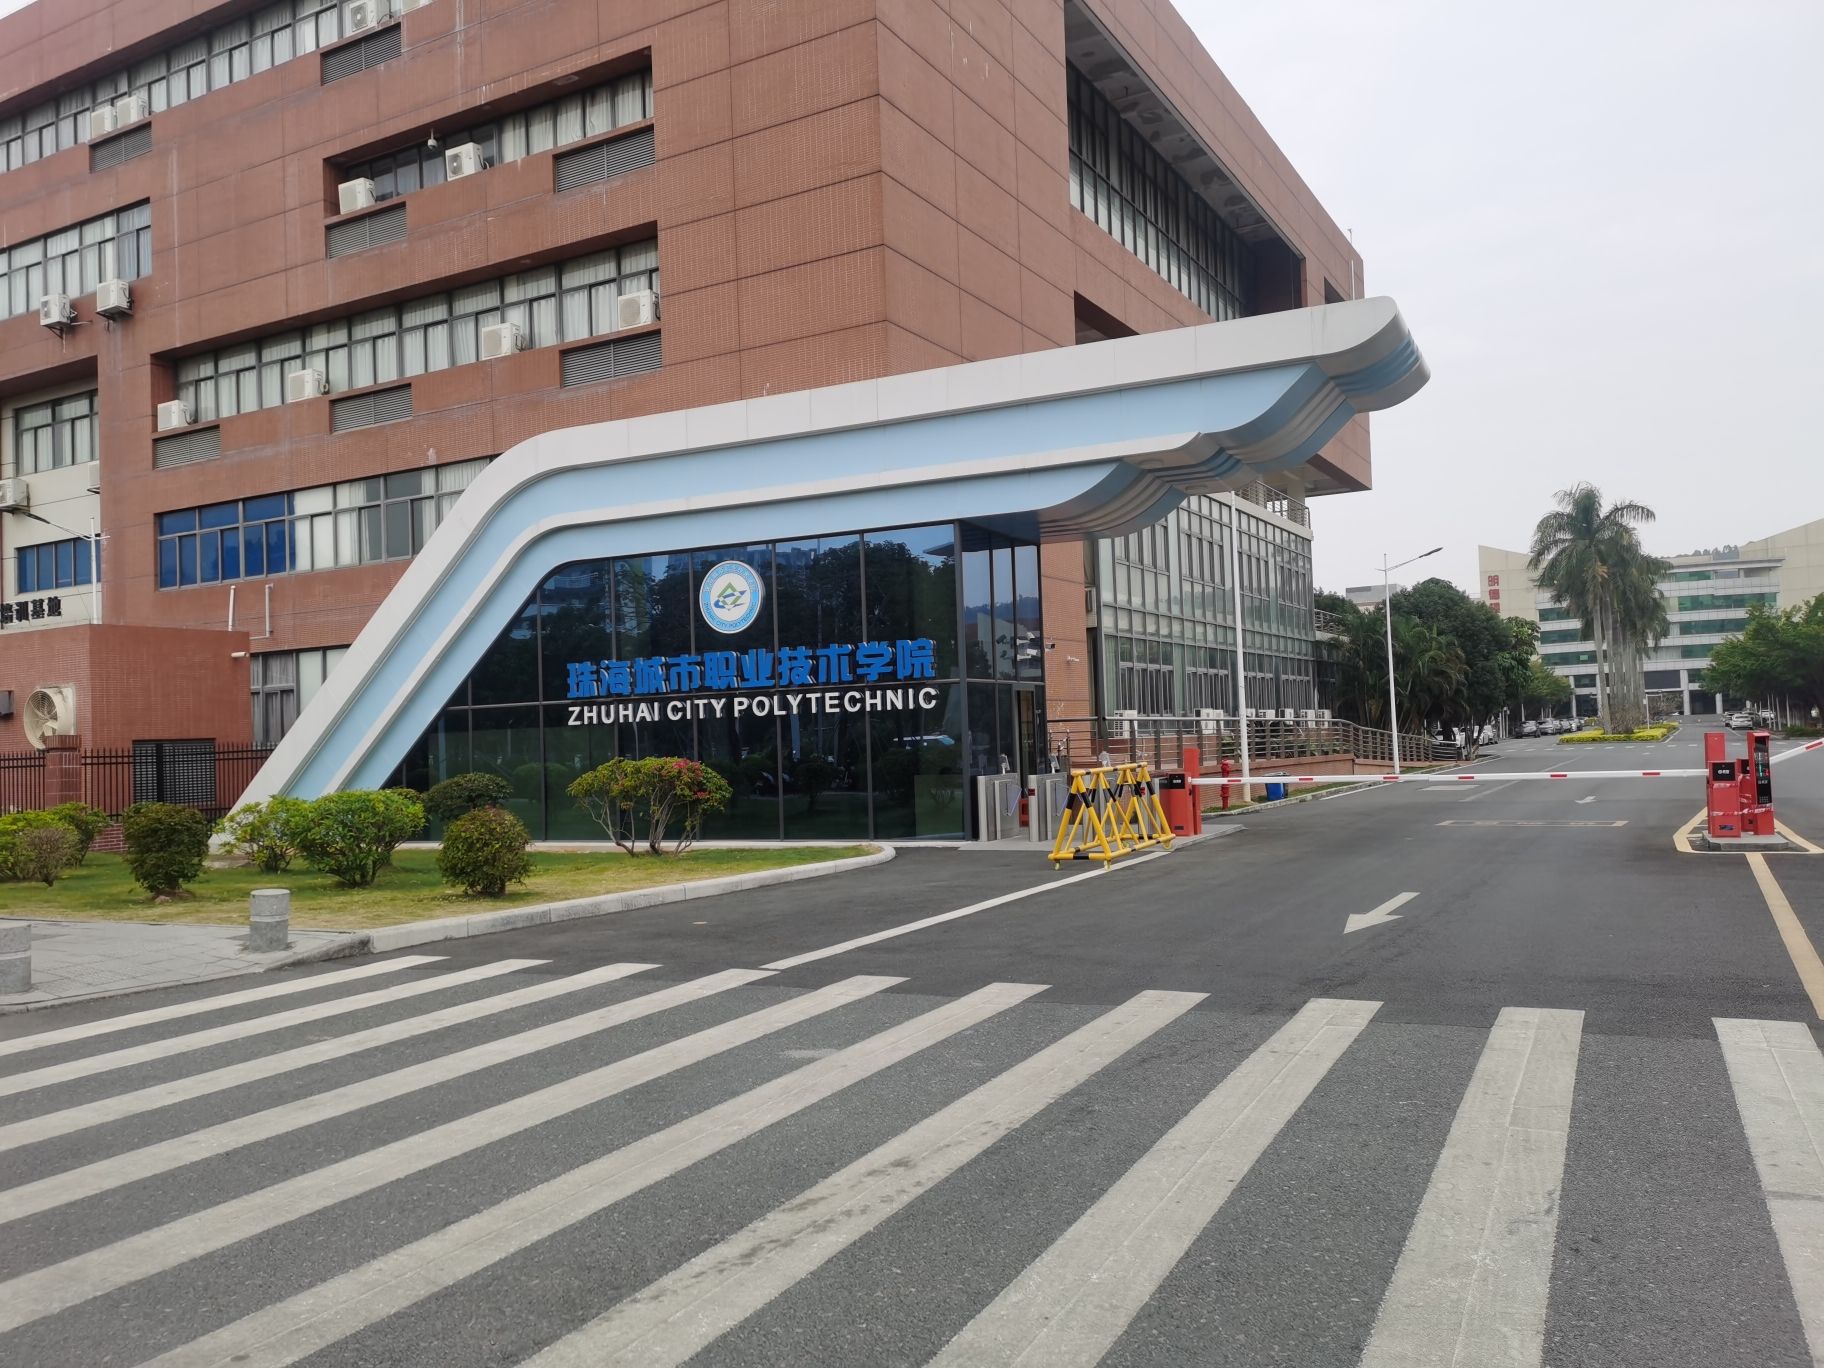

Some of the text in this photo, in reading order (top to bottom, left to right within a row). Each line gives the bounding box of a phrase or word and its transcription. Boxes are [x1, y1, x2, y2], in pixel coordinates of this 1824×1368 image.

[566, 637, 936, 699] 珠海城市职业技术学院
[567, 687, 938, 726] ZHUHAI CITY POLYTECHNIC
